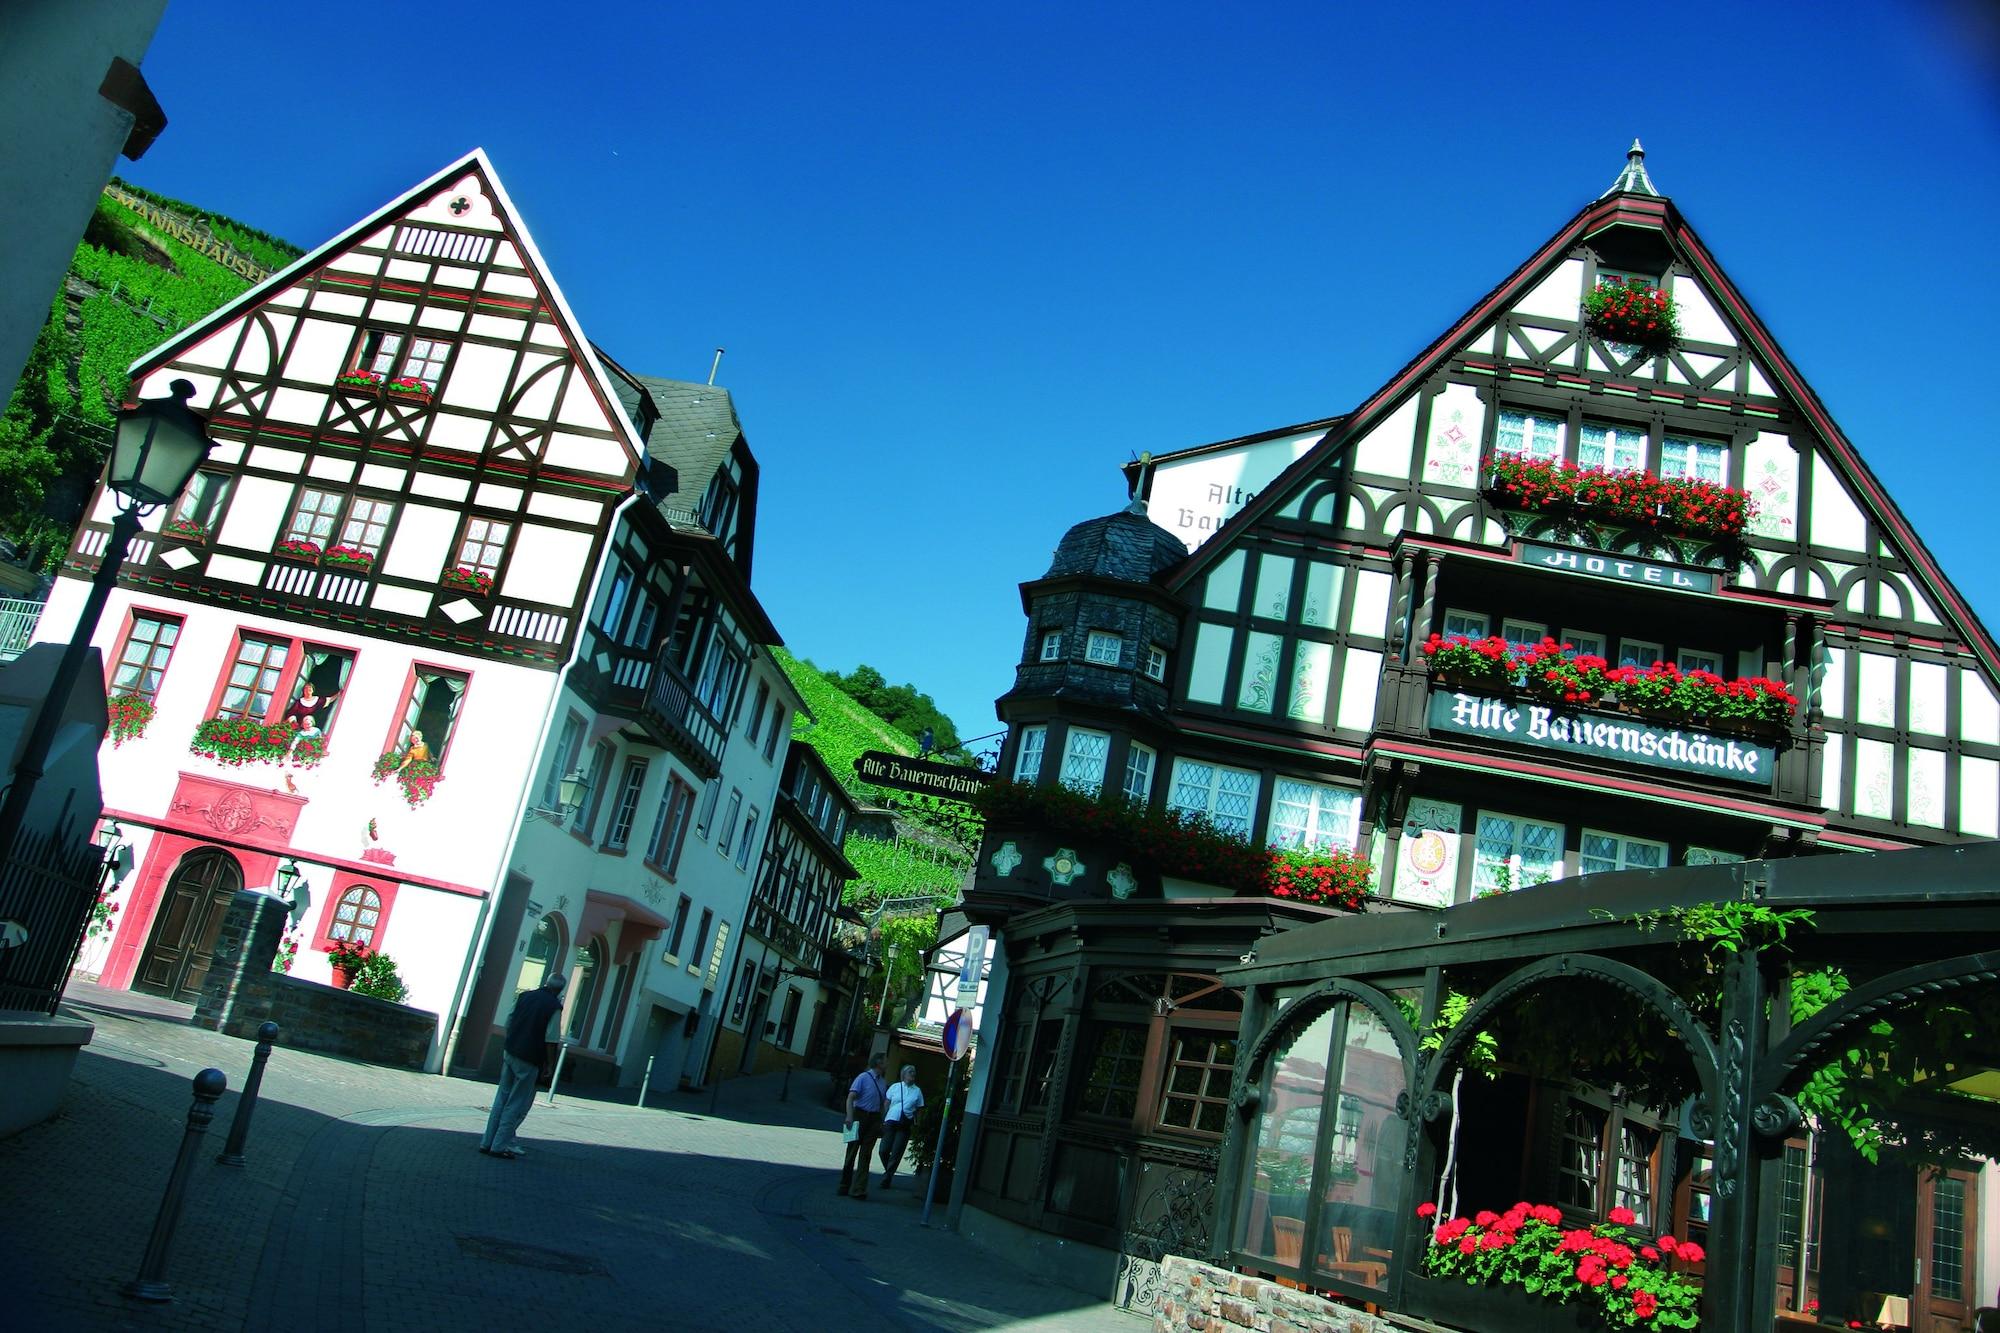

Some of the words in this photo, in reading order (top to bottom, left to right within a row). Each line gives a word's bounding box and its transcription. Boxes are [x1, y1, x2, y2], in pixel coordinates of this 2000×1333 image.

[1542, 552, 1693, 587] HOTEL
[1451, 692, 1520, 733] Alte
[1526, 705, 1759, 774] Bauernschänke
[862, 758, 887, 776] Alte
[889, 761, 990, 795] Bauernschänk
